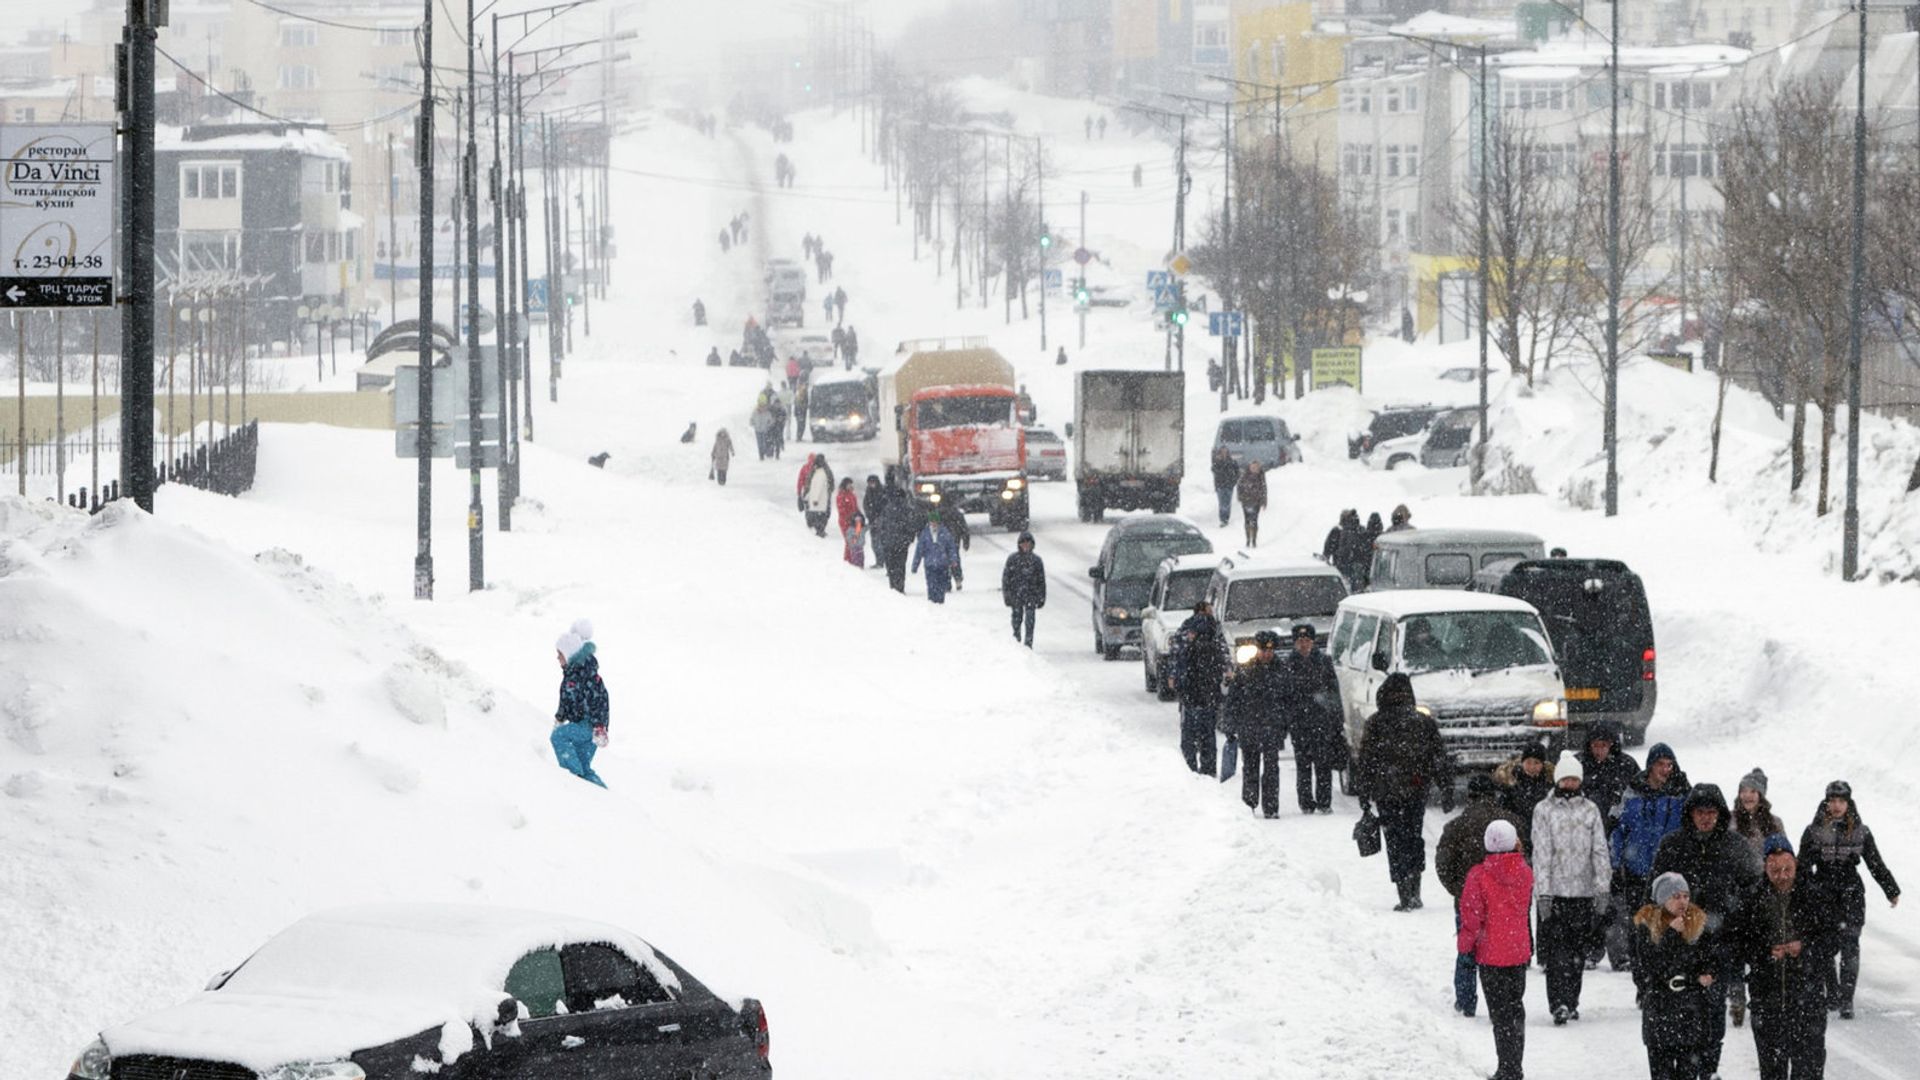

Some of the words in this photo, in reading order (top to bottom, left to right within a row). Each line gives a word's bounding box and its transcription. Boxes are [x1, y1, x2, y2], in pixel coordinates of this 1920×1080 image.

[28, 147, 87, 158] ресторан
[14, 162, 42, 180] Da
[48, 163, 101, 181] Vinci
[14, 187, 96, 197] итальянской
[36, 200, 74, 211] кухни
[33, 255, 103, 269] 23-04-38
[39, 284, 60, 294] ТРЦ
[66, 294, 73, 302] 4
[76, 295, 103, 303] этаж
